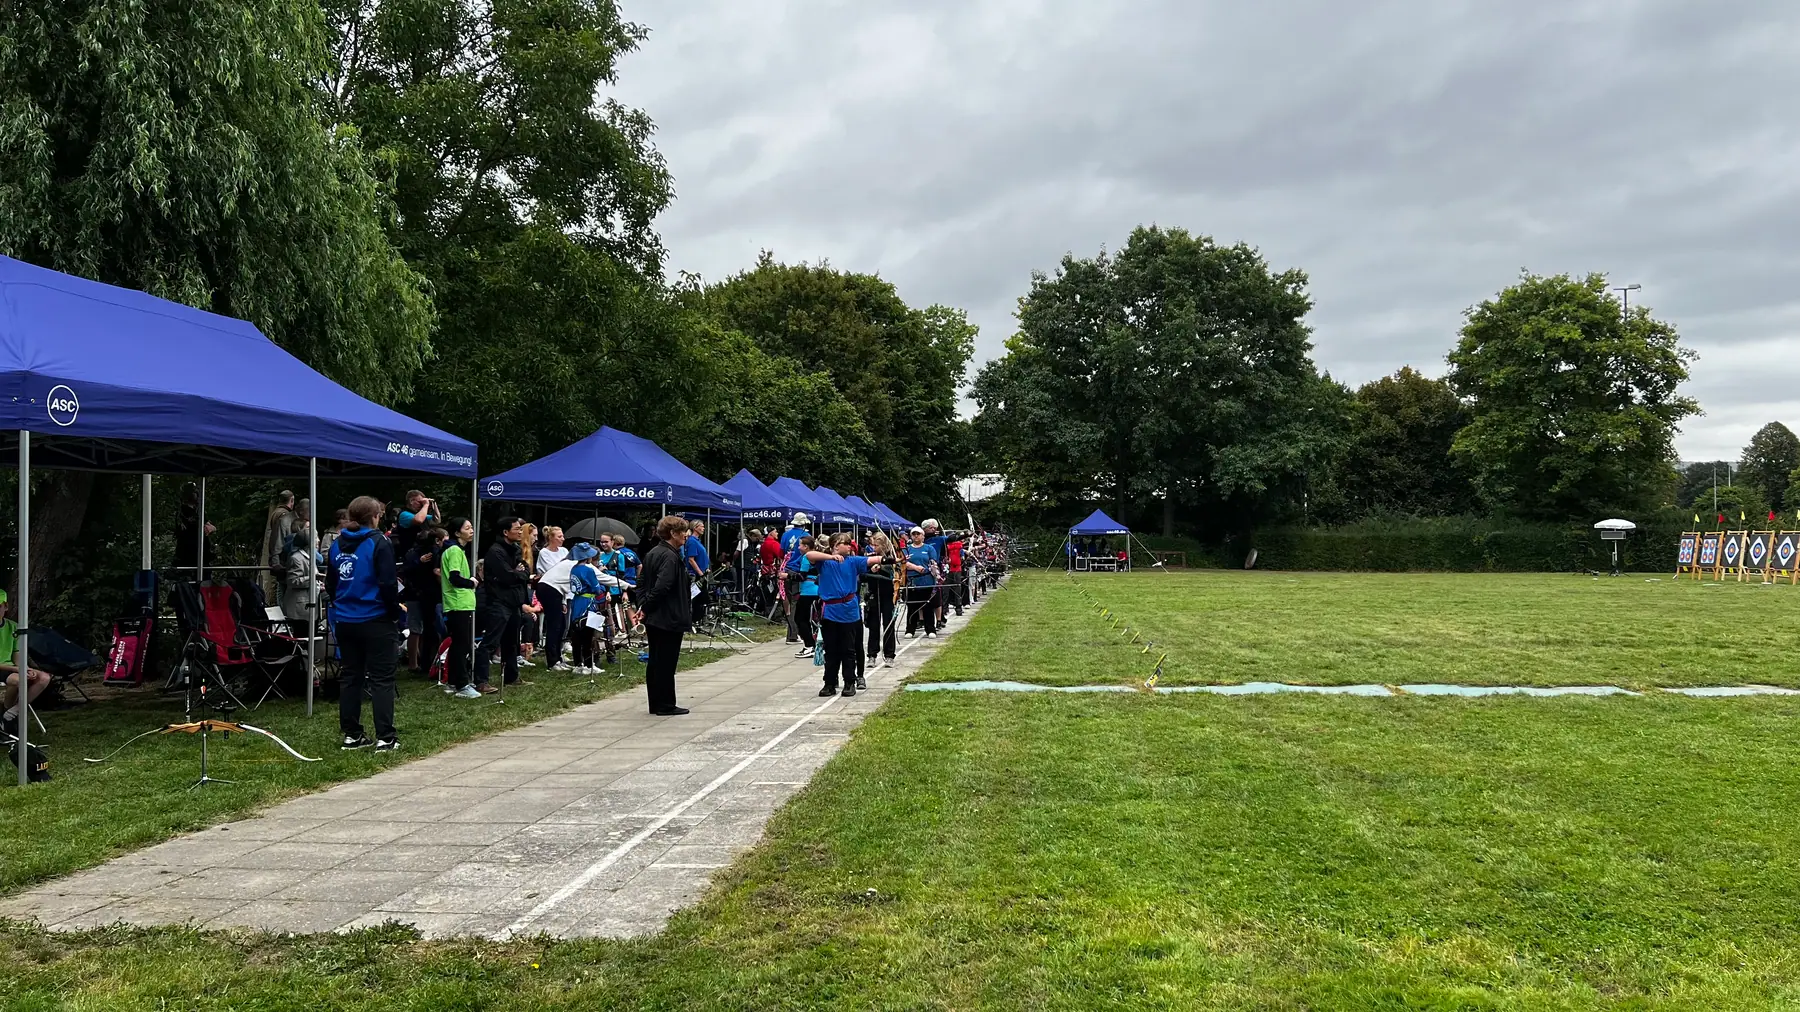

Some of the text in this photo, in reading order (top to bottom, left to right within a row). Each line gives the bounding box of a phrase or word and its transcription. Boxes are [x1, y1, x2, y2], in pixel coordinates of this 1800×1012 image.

[51, 398, 76, 412] ASC
[387, 442, 400, 453] ASC
[401, 444, 409, 455] 46
[595, 487, 655, 498] asc46.de
[743, 510, 782, 518] asc46.de
